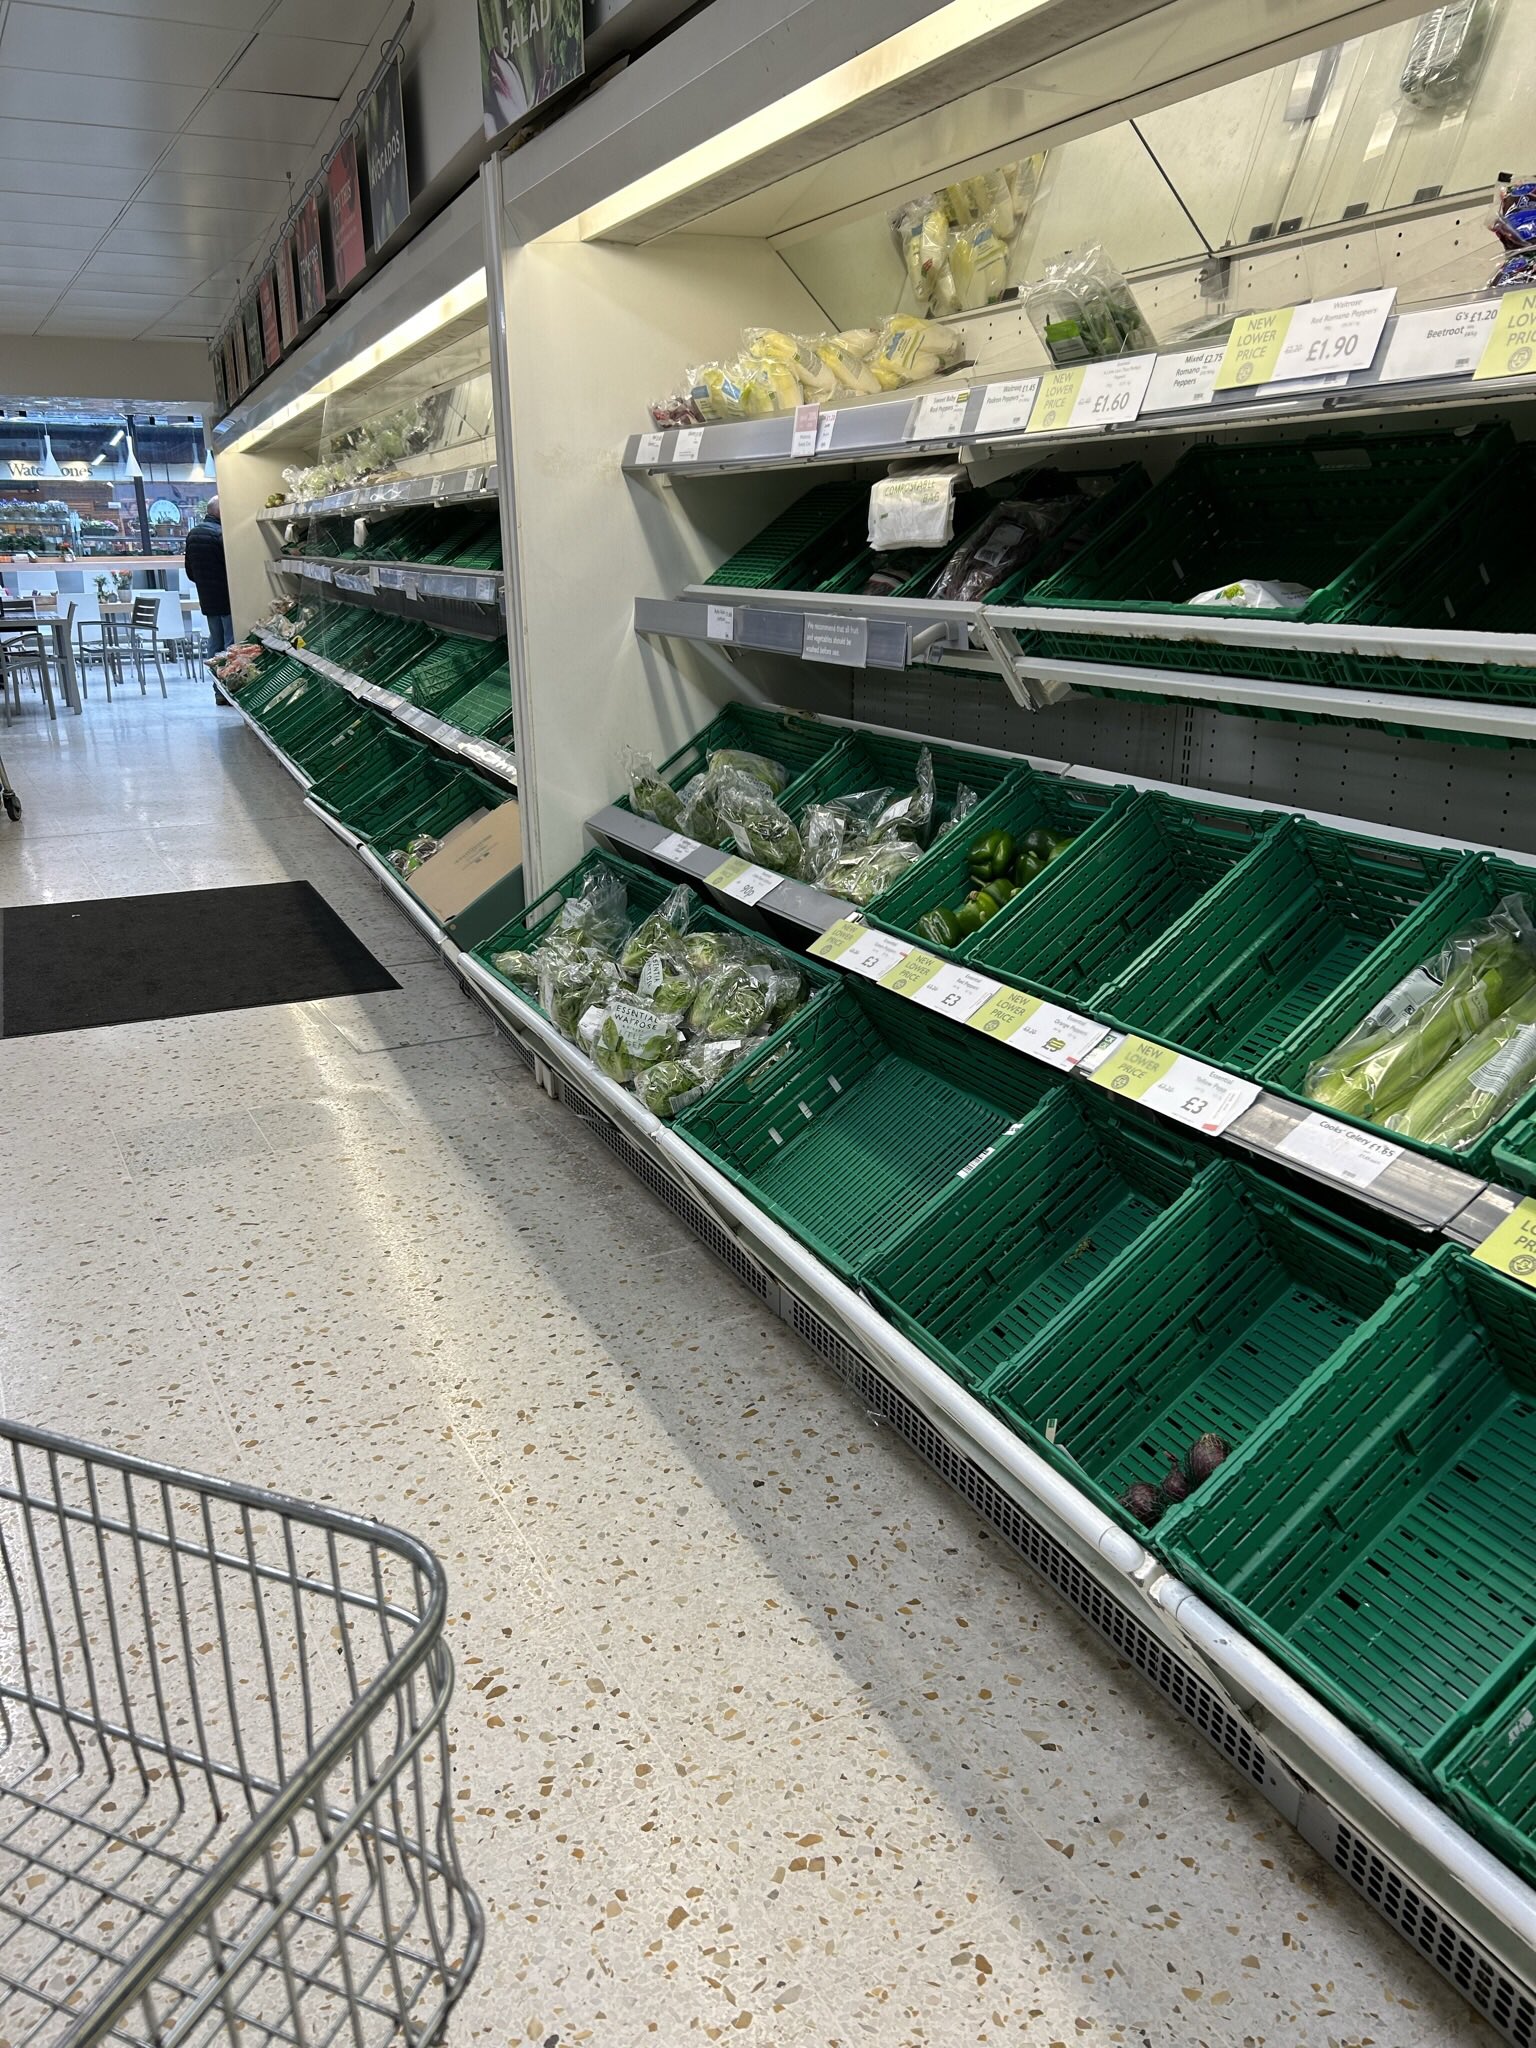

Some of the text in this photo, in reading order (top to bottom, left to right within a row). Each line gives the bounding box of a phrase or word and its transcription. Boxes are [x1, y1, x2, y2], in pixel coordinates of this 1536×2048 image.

[502, 0, 552, 59] SALAD
[1333, 299, 1363, 310] Waitrose
[1351, 307, 1378, 318] Peppers
[1469, 309, 1498, 322] £1.20
[1247, 315, 1277, 331] NEW
[1237, 329, 1277, 347] LOWER
[1426, 325, 1465, 339] Beetroot
[1235, 346, 1267, 362] PRICE
[1305, 333, 1359, 362] £1.90
[1184, 352, 1224, 364] Mixed £2.75
[1053, 372, 1074, 384] NEW
[1176, 366, 1200, 376] Romano
[1021, 383, 1036, 392] £1.45
[1173, 377, 1197, 388] Peppers
[1045, 384, 1074, 397] LOWER
[1043, 397, 1066, 409] PRICE
[1092, 391, 1130, 413] £1.60
[7, 462, 94, 477] Wateones
[885, 480, 936, 497] COMPOSTABLE
[923, 491, 940, 503] BAG
[740, 884, 755, 898] 90p
[832, 928, 855, 941] LOWER
[842, 923, 857, 934] NEW
[826, 937, 843, 947] PRICE
[861, 955, 879, 968] £3
[916, 955, 935, 967] NEW
[905, 961, 931, 976] LOWER
[900, 970, 921, 982] PRICE
[941, 993, 961, 1007] £3
[1008, 993, 1031, 1006] NEW
[996, 1000, 1026, 1017] LOWER
[990, 1009, 1015, 1023] PRICE
[1137, 1043, 1163, 1059] NEW
[1124, 1052, 1160, 1072] LOWER
[1118, 1063, 1147, 1079] PRICE
[1208, 1070, 1235, 1086] Essential
[1180, 1096, 1209, 1115] £3
[1319, 1120, 1346, 1134] Cooks'
[1345, 1131, 1370, 1146] Celery
[1367, 1143, 1396, 1158] £1.65
